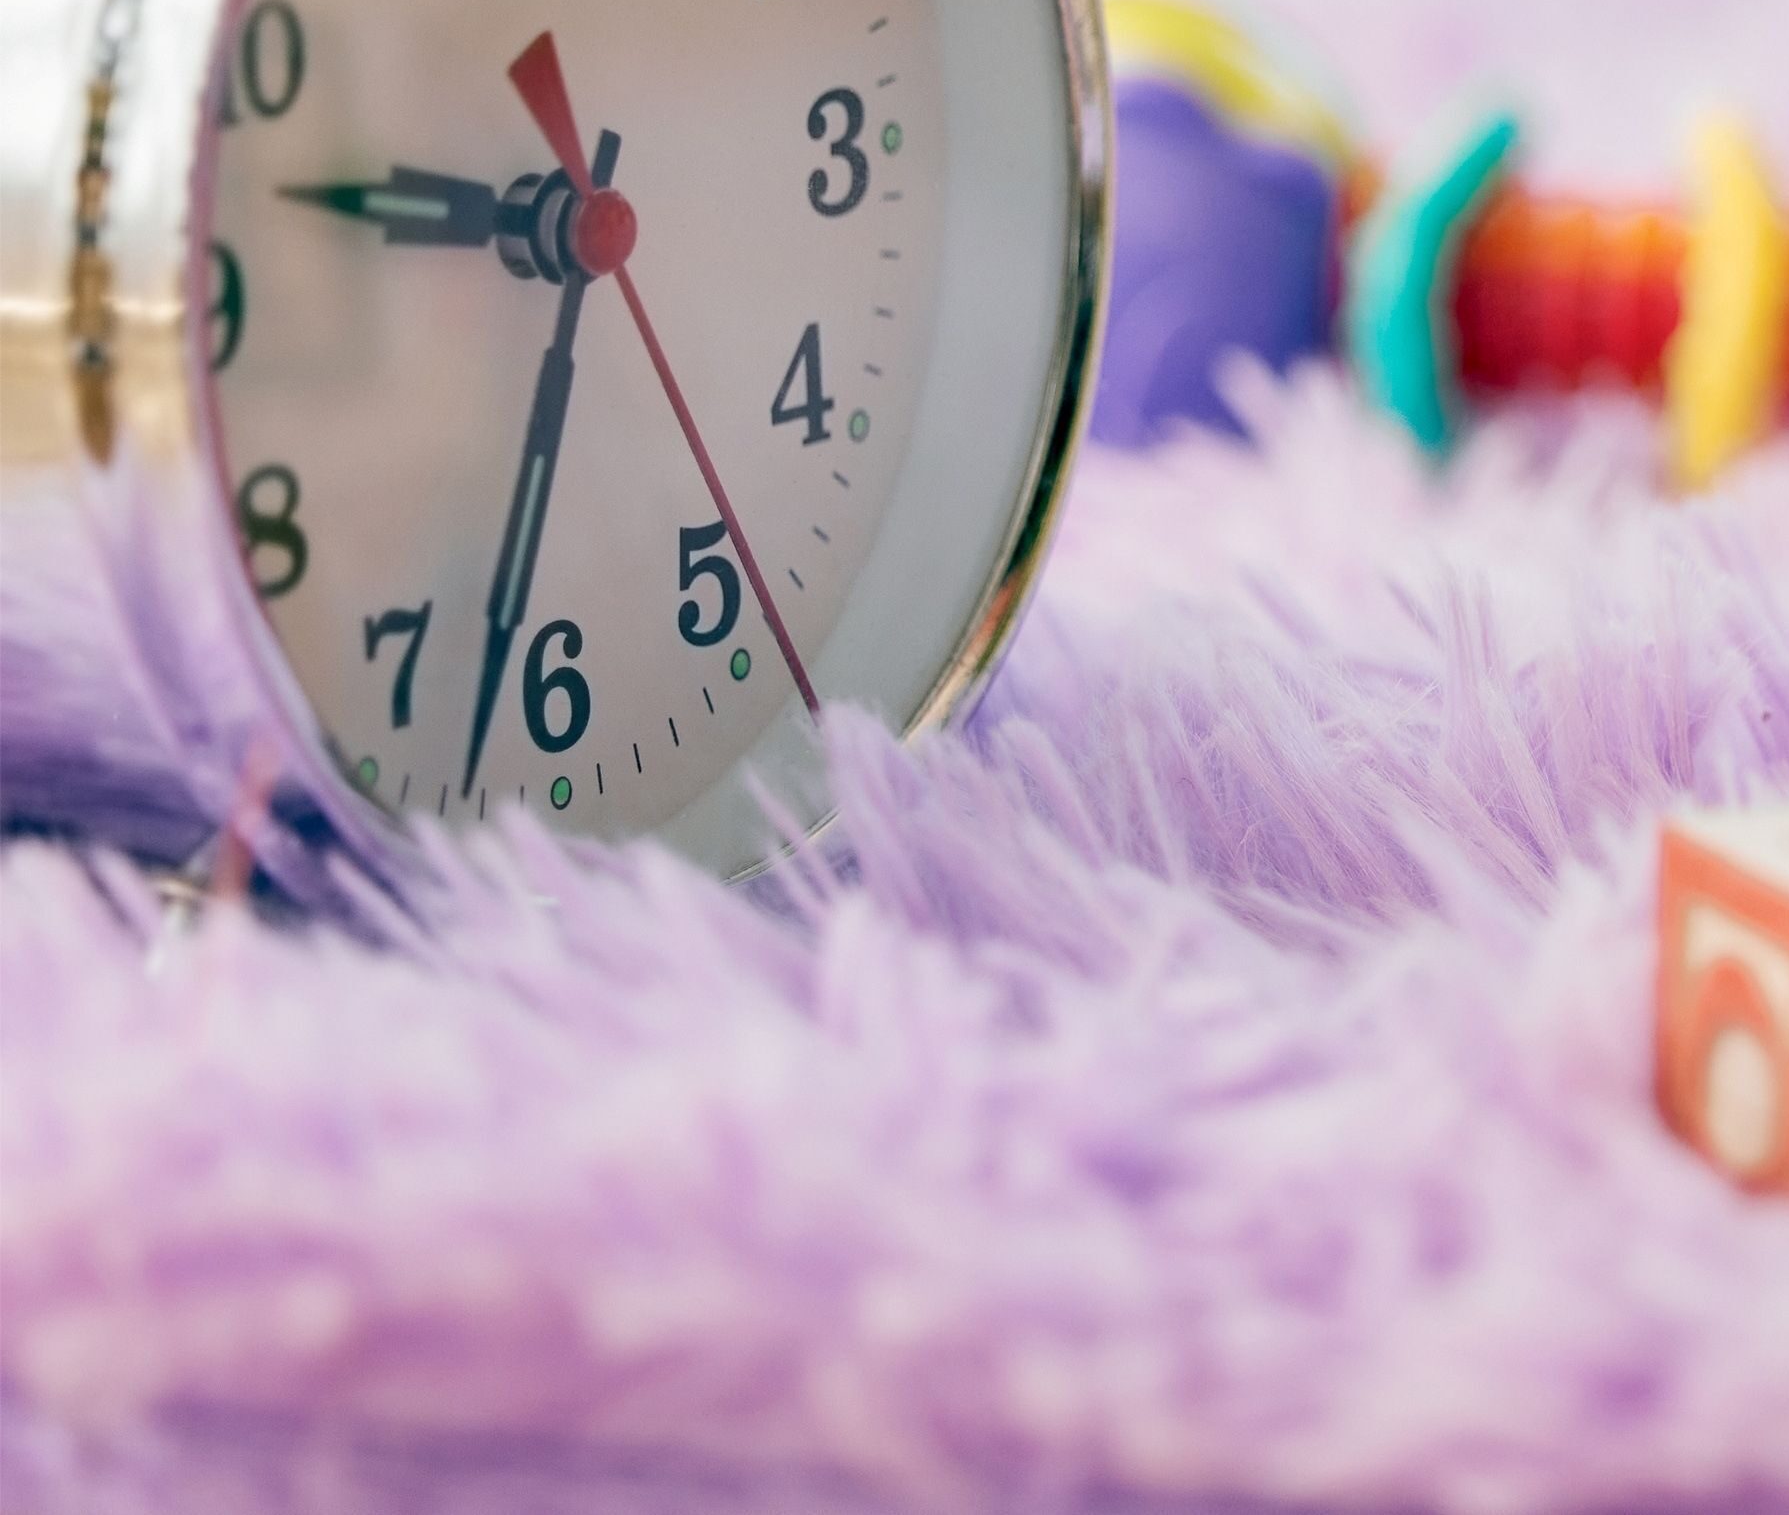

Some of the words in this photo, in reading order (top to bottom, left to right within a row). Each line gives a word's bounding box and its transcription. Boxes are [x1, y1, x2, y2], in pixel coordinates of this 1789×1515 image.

[806, 87, 870, 218] 3
[769, 322, 834, 447] 4
[239, 464, 307, 599] 8
[677, 520, 743, 647] 5
[364, 600, 432, 729] 7
[521, 618, 592, 754] 6
